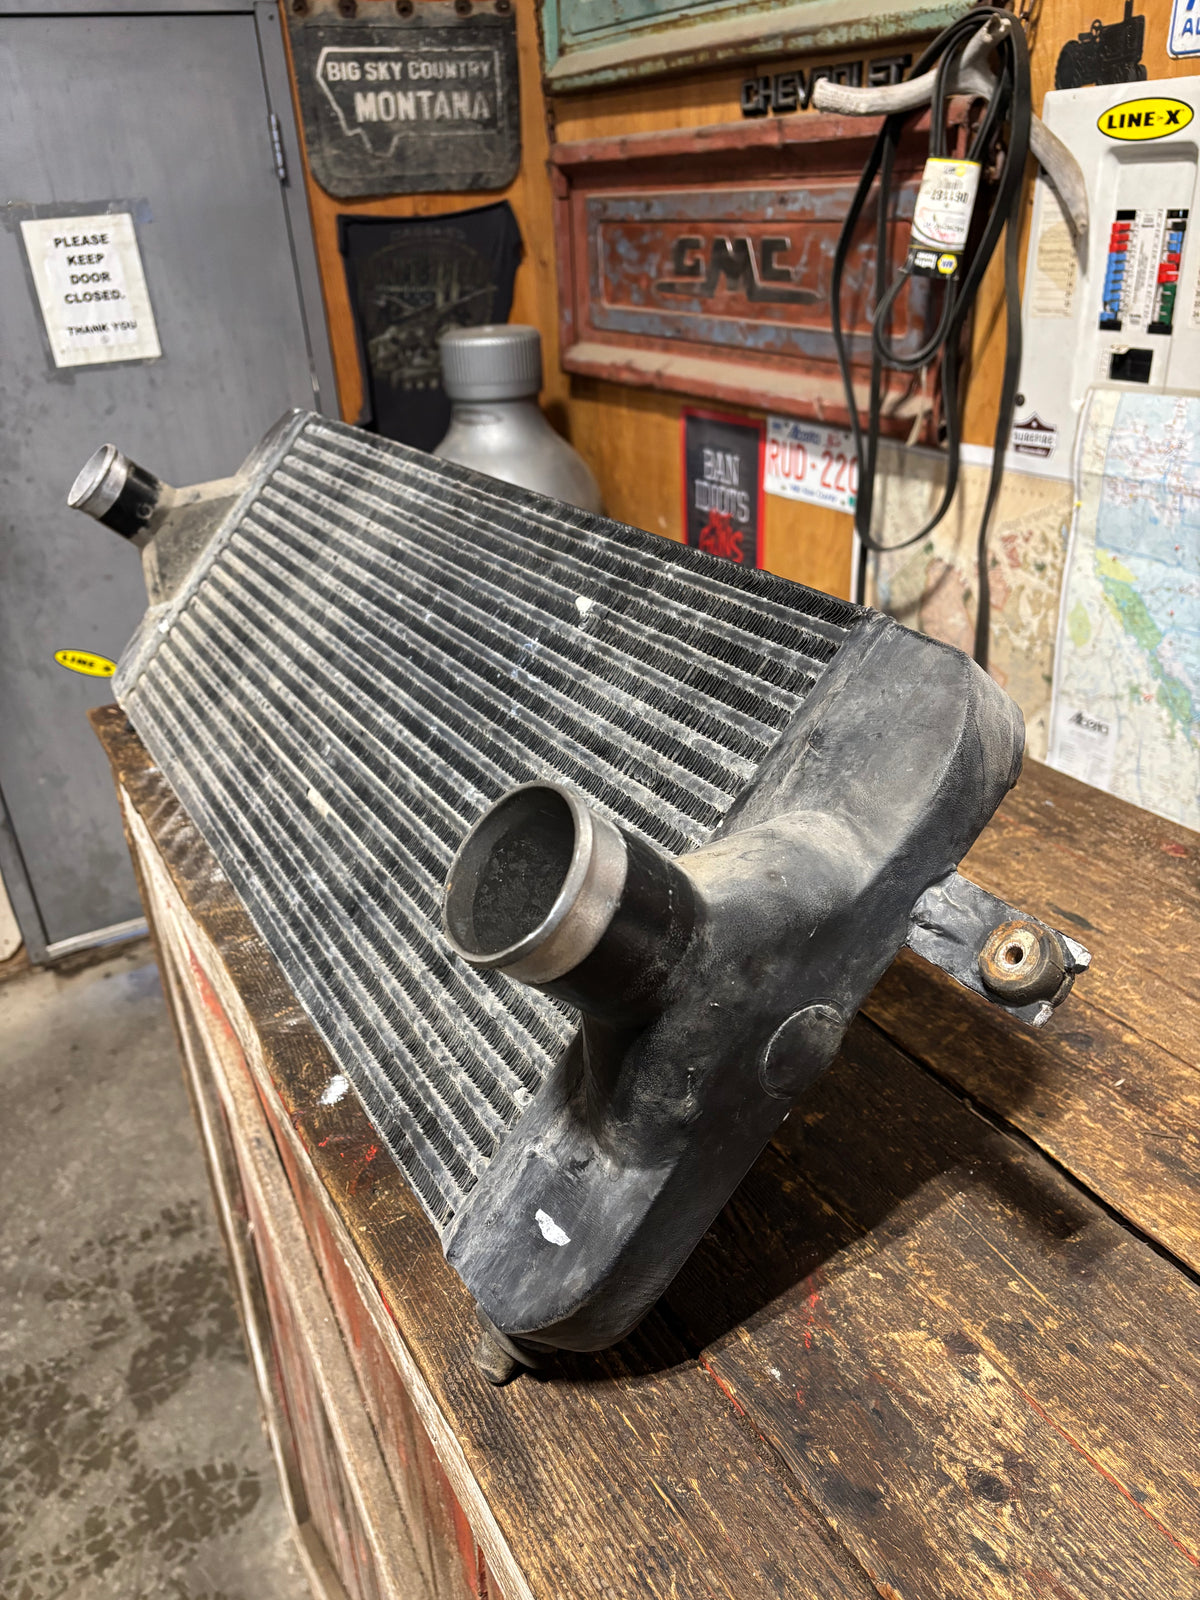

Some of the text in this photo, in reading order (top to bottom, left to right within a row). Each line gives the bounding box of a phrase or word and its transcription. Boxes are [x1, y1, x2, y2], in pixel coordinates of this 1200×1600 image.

[326, 60, 492, 82] BIG SKY COUNTRY
[354, 91, 491, 123] MONTANA
[53, 233, 110, 248] PLEASE
[66, 253, 105, 267] KEEP
[660, 235, 815, 302] GMC
[69, 271, 111, 286] DOOR
[67, 319, 138, 337] THANK YOU
[703, 448, 741, 487] BAN
[695, 479, 750, 524] IDIOTS
